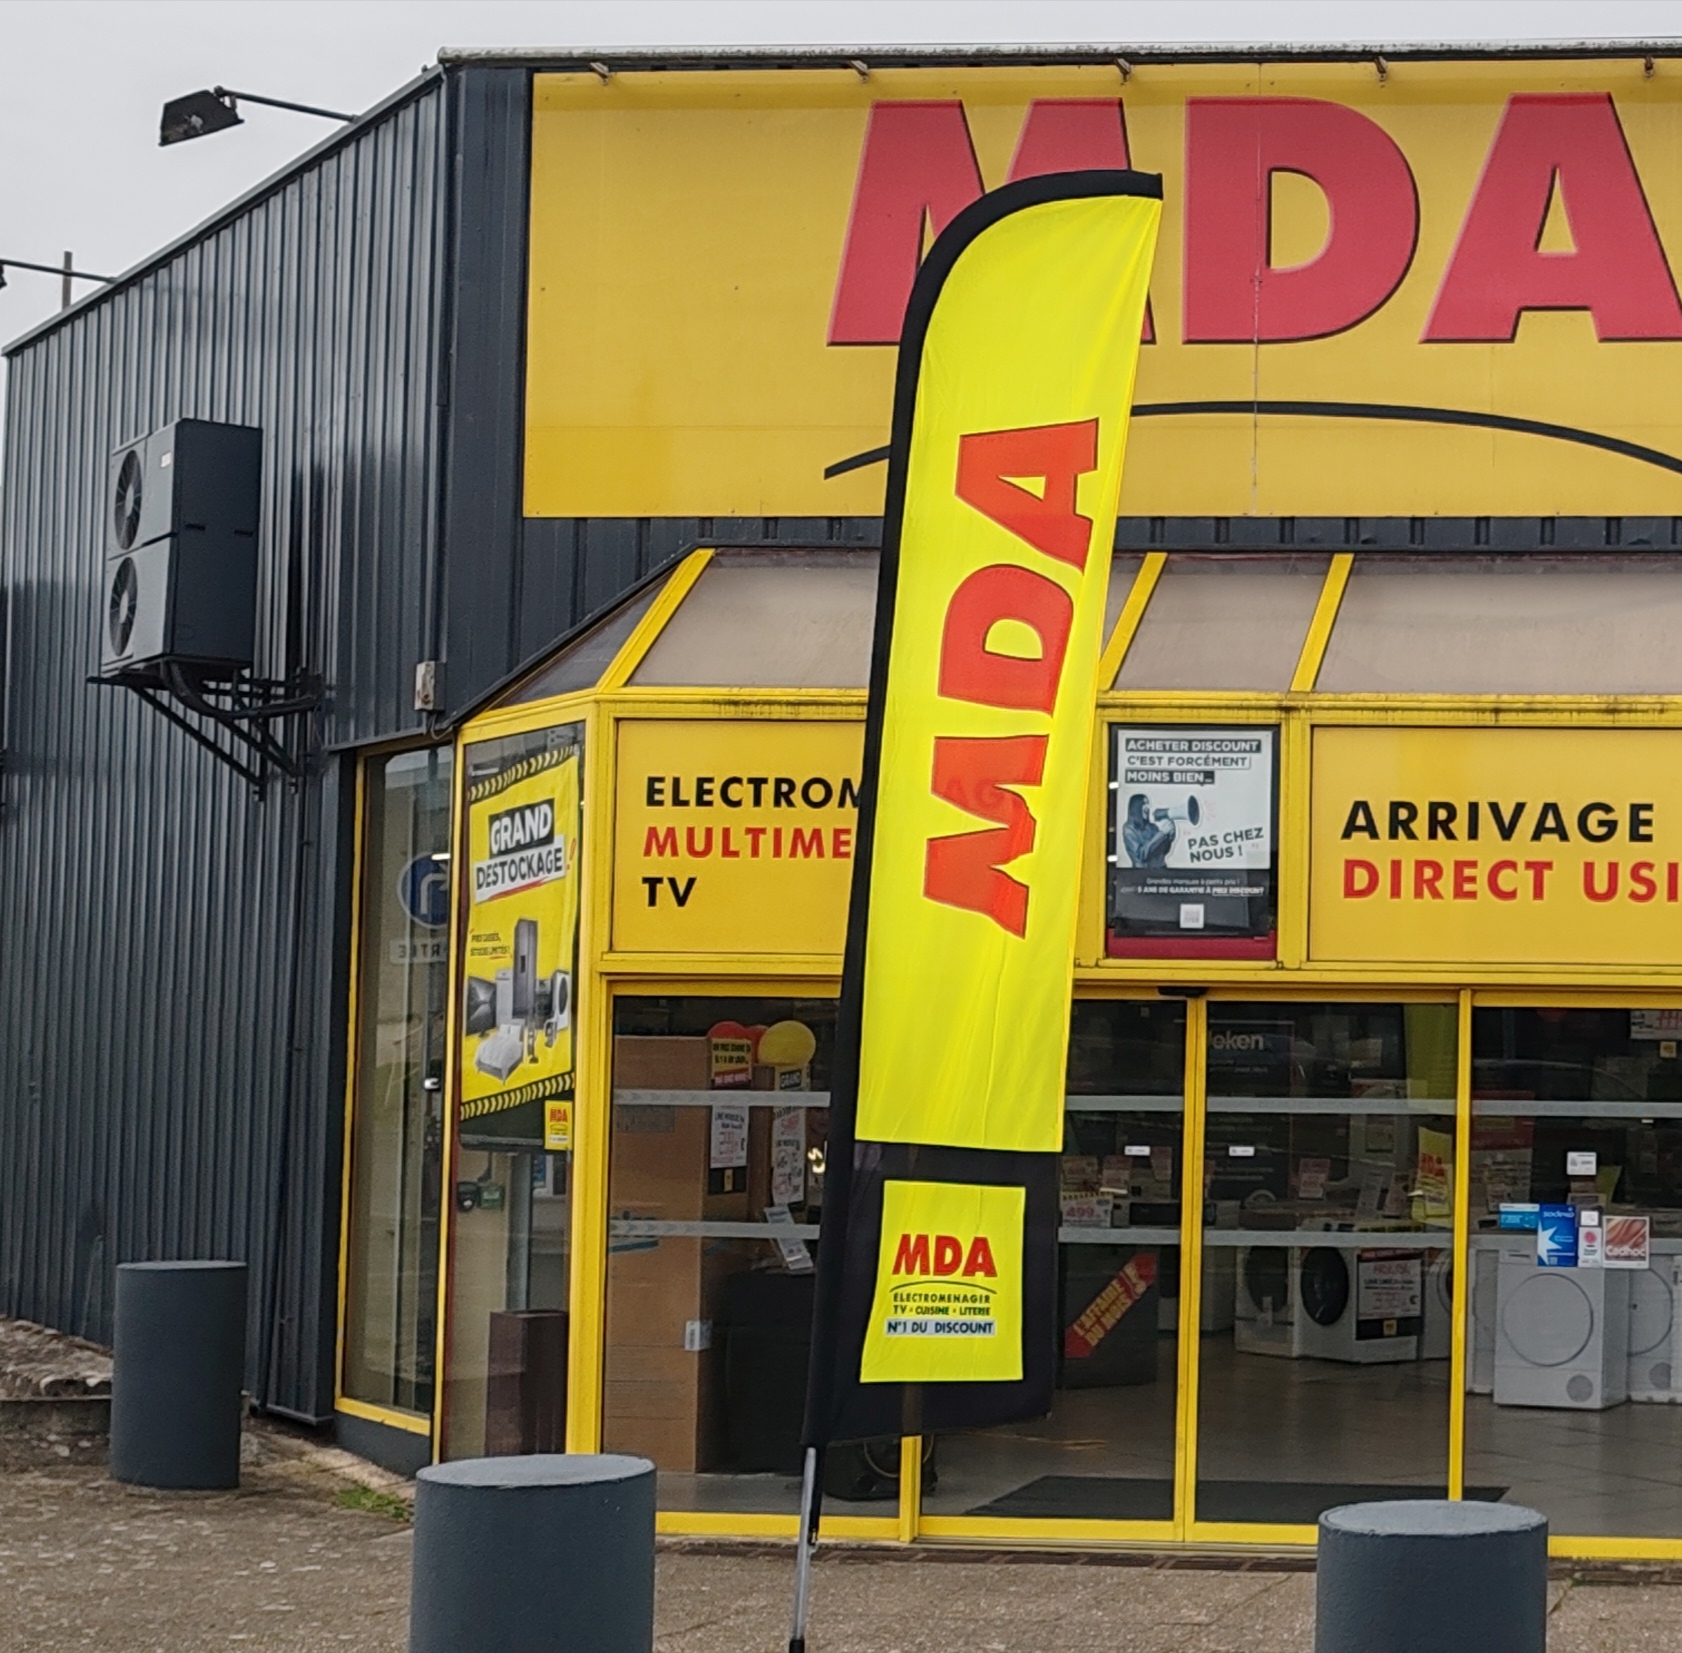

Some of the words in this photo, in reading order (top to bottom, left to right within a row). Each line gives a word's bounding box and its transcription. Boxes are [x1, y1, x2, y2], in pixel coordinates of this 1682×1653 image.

[923, 417, 1099, 939] MDA
[1127, 740, 1188, 751] ACHETER
[1192, 740, 1259, 751] DISCOUNT
[1127, 755, 1163, 766] C'EST
[1167, 753, 1247, 767] FORCÉMENT
[1127, 771, 1170, 782] MOINS
[645, 776, 860, 808] ELECTROM
[490, 803, 552, 854] GRAND
[1341, 800, 1654, 843] ARRIVAGE
[642, 826, 851, 859] MULTIME
[1188, 834, 1219, 850] PAS
[1223, 827, 1264, 845] CHEZ
[476, 847, 562, 890] DESTOCKAGE
[1190, 846, 1234, 863] NOUS
[642, 877, 697, 907] TV
[1344, 859, 1553, 901] DIRECT
[892, 1234, 998, 1278] MDA
[893, 1293, 990, 1304] ELECTROMENAGER
[893, 1305, 907, 1314] TV
[915, 1306, 950, 1315] CUISINE
[959, 1307, 990, 1316] LITERIE
[911, 1322, 927, 1333] DU
[935, 1322, 994, 1334] DISCOUNT
